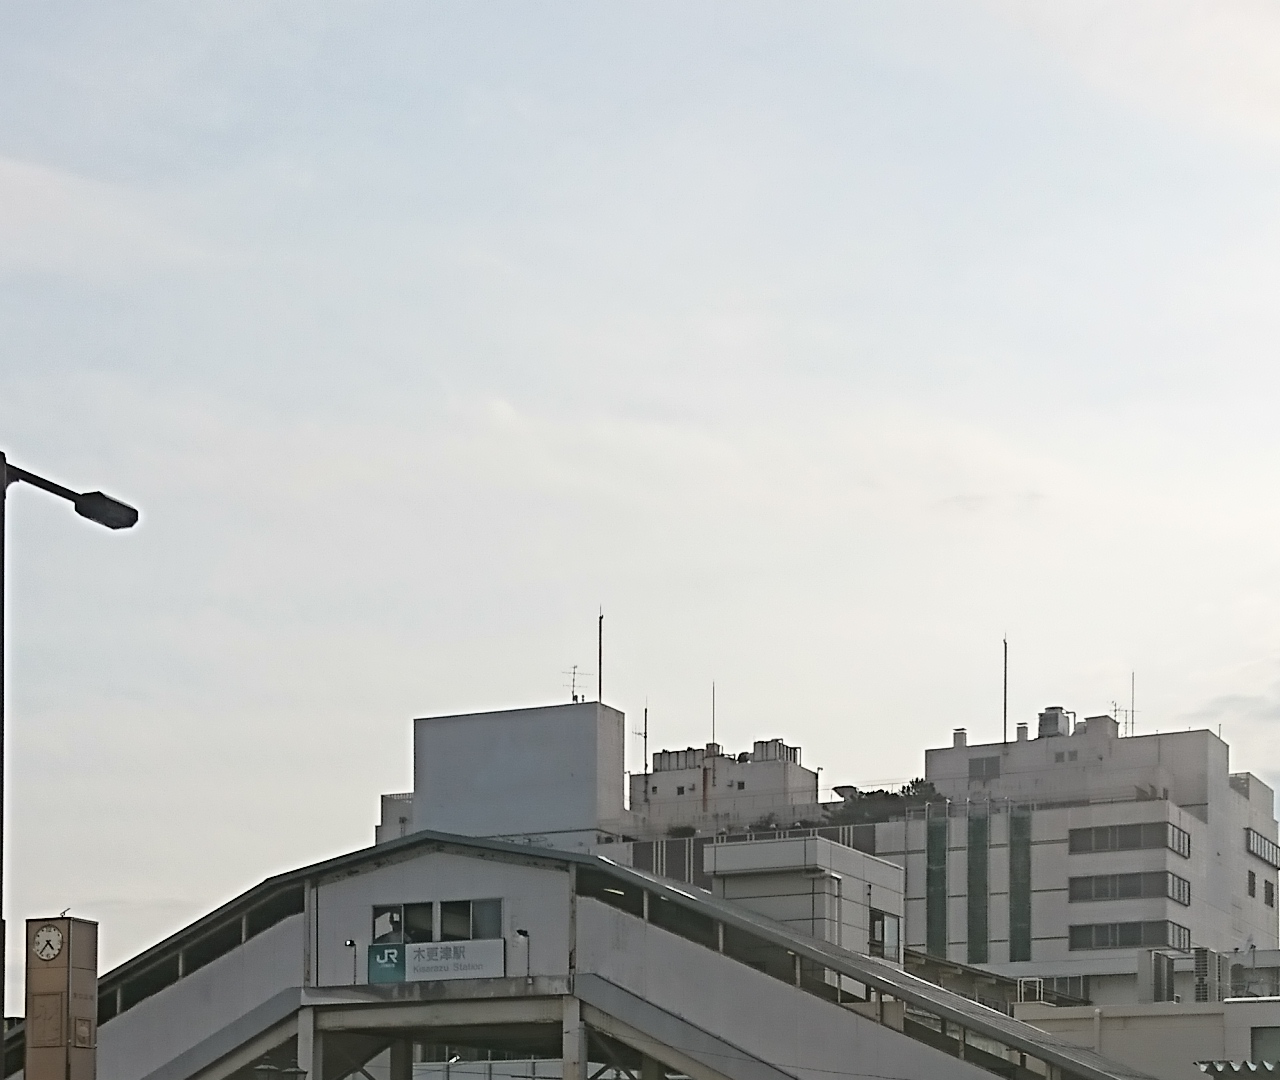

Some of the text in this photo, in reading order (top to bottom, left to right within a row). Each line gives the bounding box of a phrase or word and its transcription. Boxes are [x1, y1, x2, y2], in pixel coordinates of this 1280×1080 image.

[376, 948, 398, 963] JR
[413, 945, 466, 963] 木更津駅
[413, 962, 484, 974] Kisarazu Station
